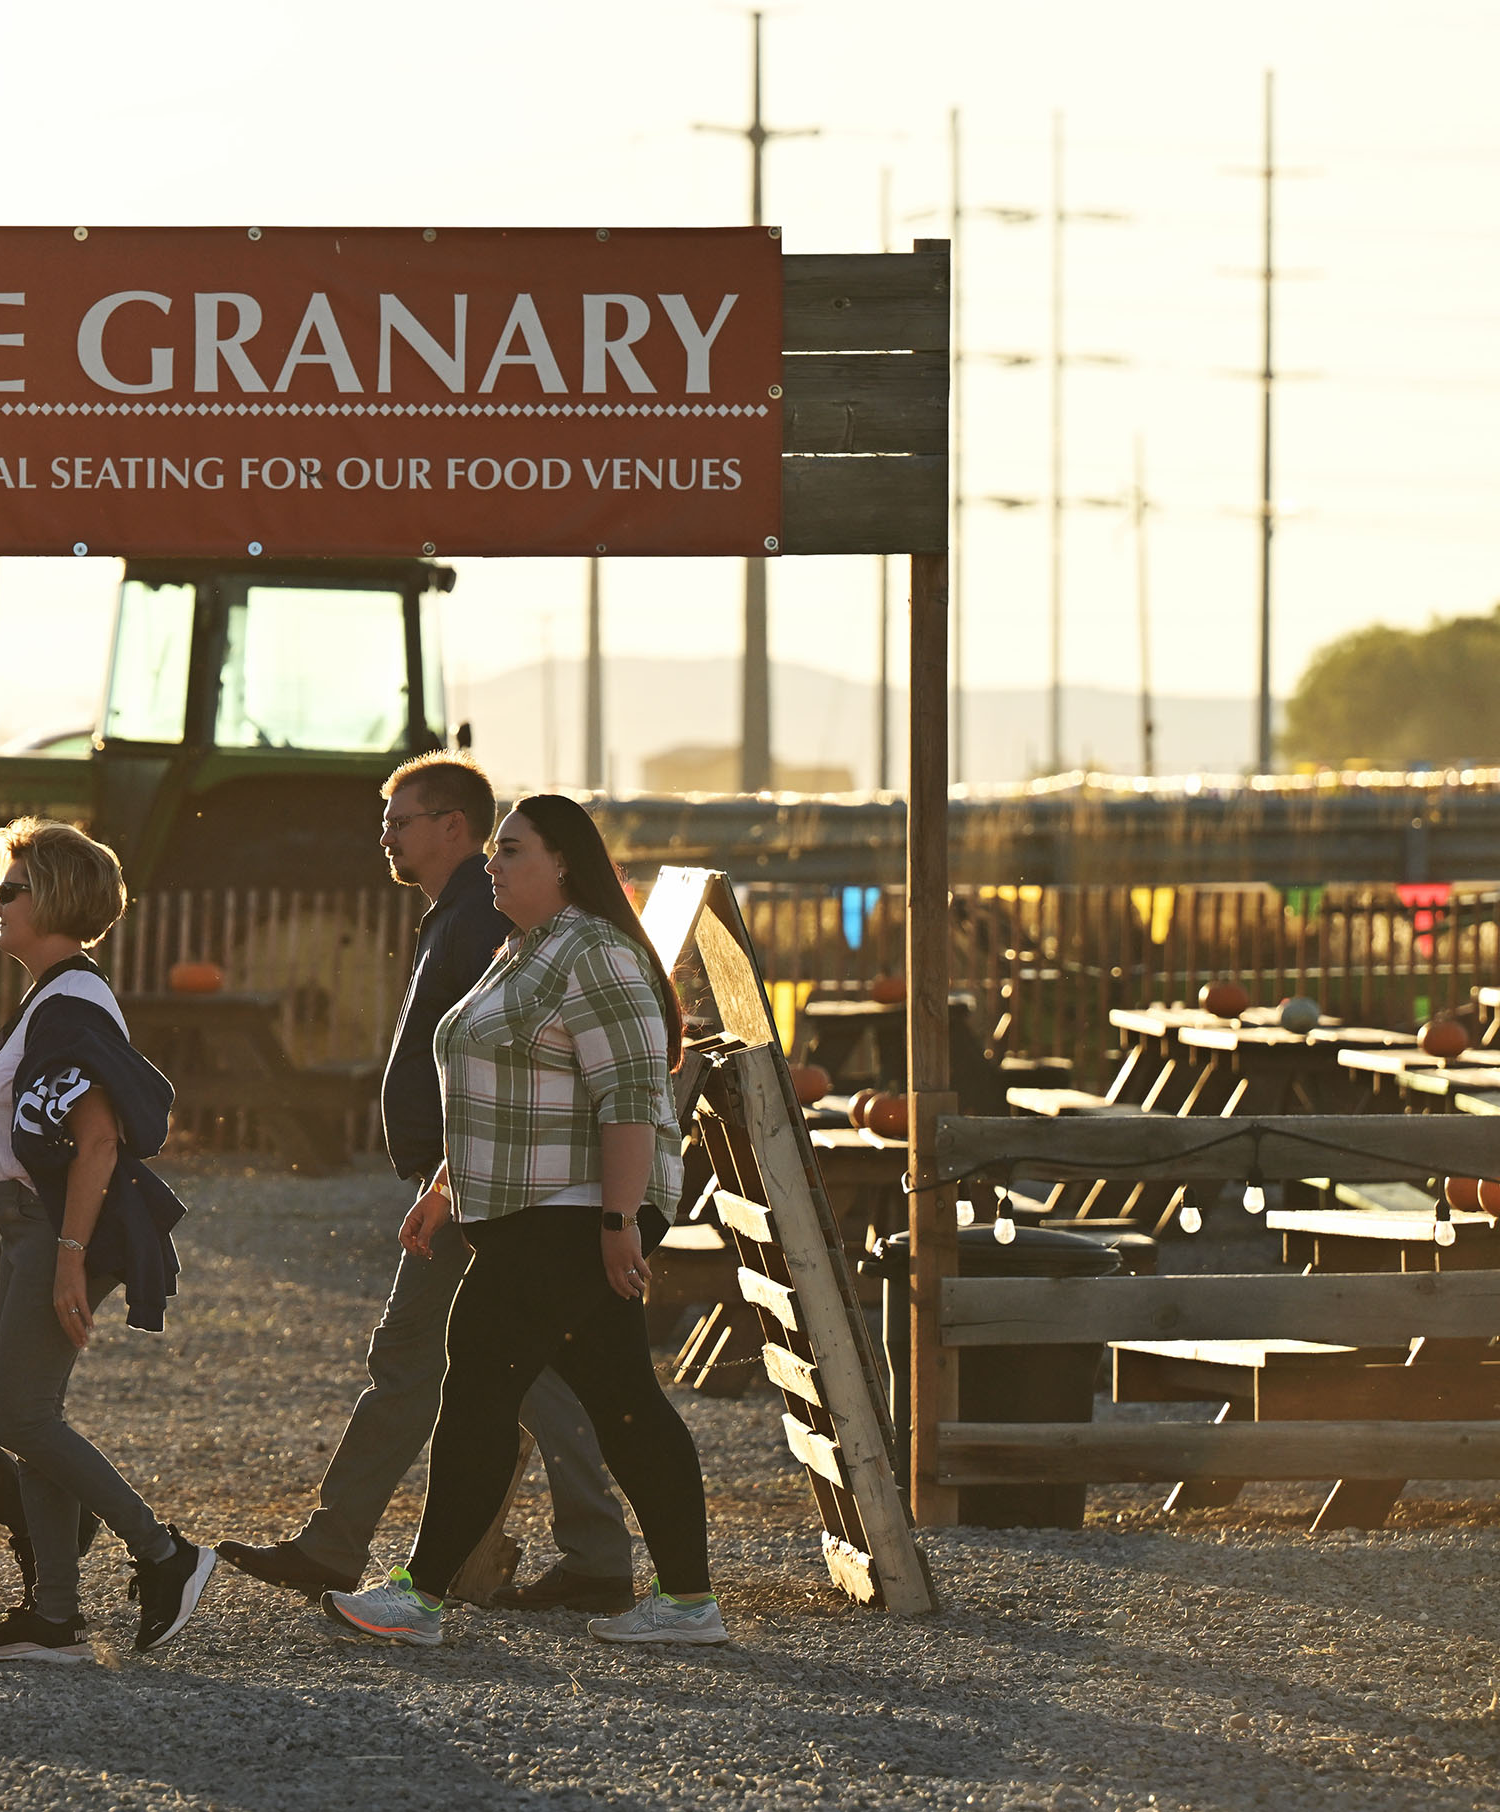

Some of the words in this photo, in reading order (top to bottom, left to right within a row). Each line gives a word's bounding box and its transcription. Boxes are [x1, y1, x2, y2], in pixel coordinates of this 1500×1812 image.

[77, 290, 740, 396] GRANARY
[51, 456, 226, 491] SEATING
[242, 457, 324, 491] FOR
[337, 457, 433, 492] OUR
[447, 457, 573, 492] FOOD
[583, 458, 743, 492] VENUES
